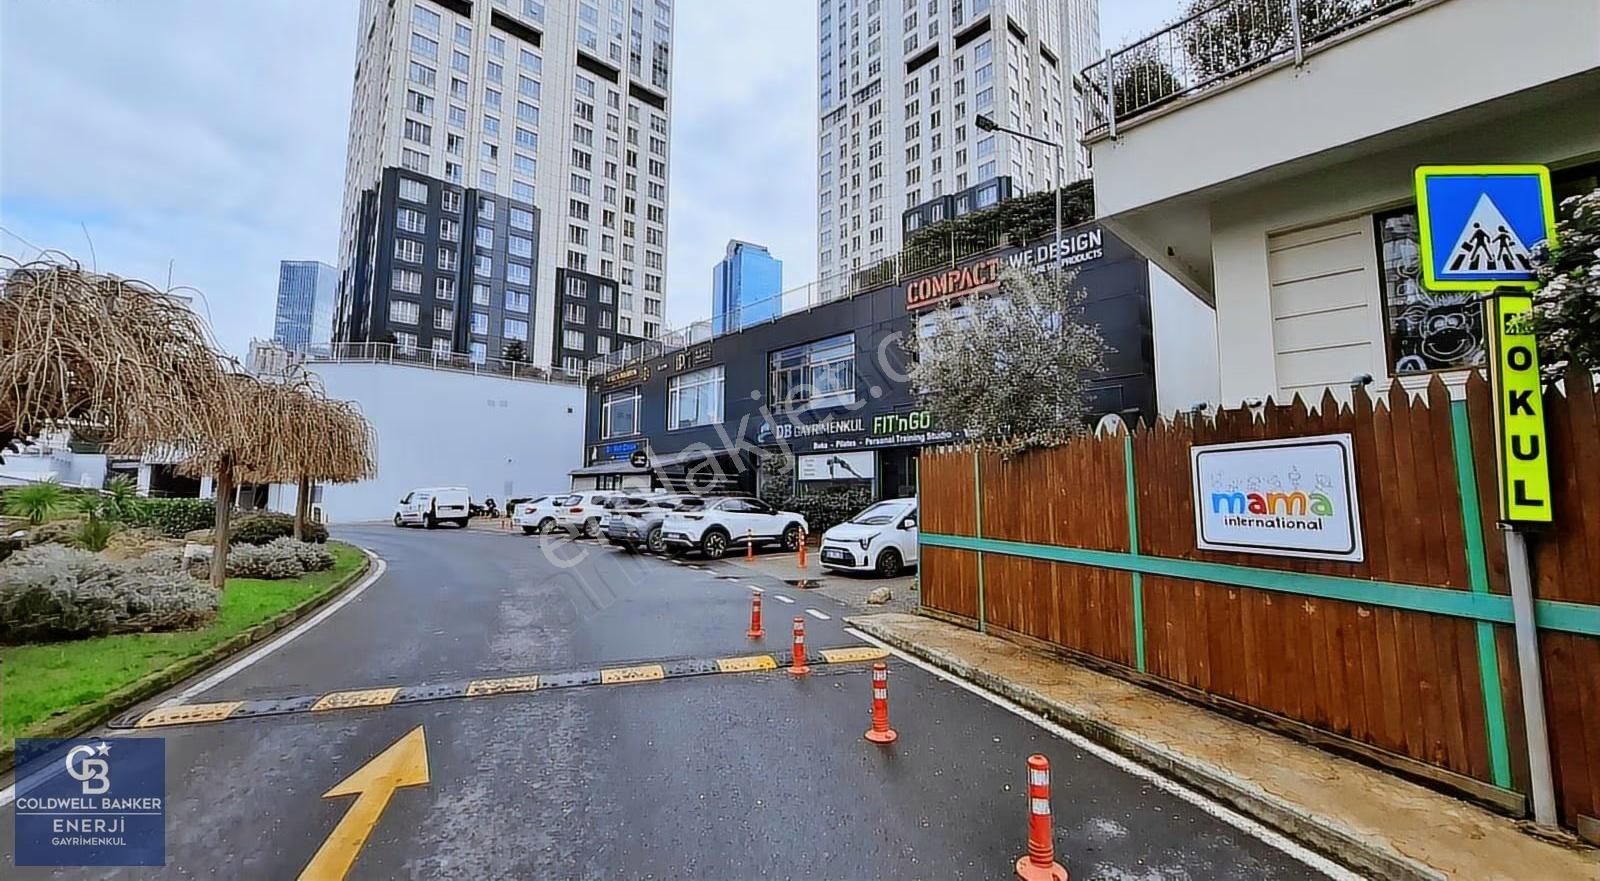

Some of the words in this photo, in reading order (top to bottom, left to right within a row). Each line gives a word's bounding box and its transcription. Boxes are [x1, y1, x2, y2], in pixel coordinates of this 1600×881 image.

[1037, 229, 1102, 263] DESIGN
[1061, 248, 1103, 267] PRODUCTS
[906, 257, 1000, 304] COMPACT
[776, 424, 792, 440] DB
[1507, 345, 1545, 507] OKUL
[865, 435, 895, 446] Personal
[896, 434, 925, 443] Training
[926, 431, 952, 441] Studio
[1211, 492, 1334, 516] mama
[1224, 515, 1323, 531] international
